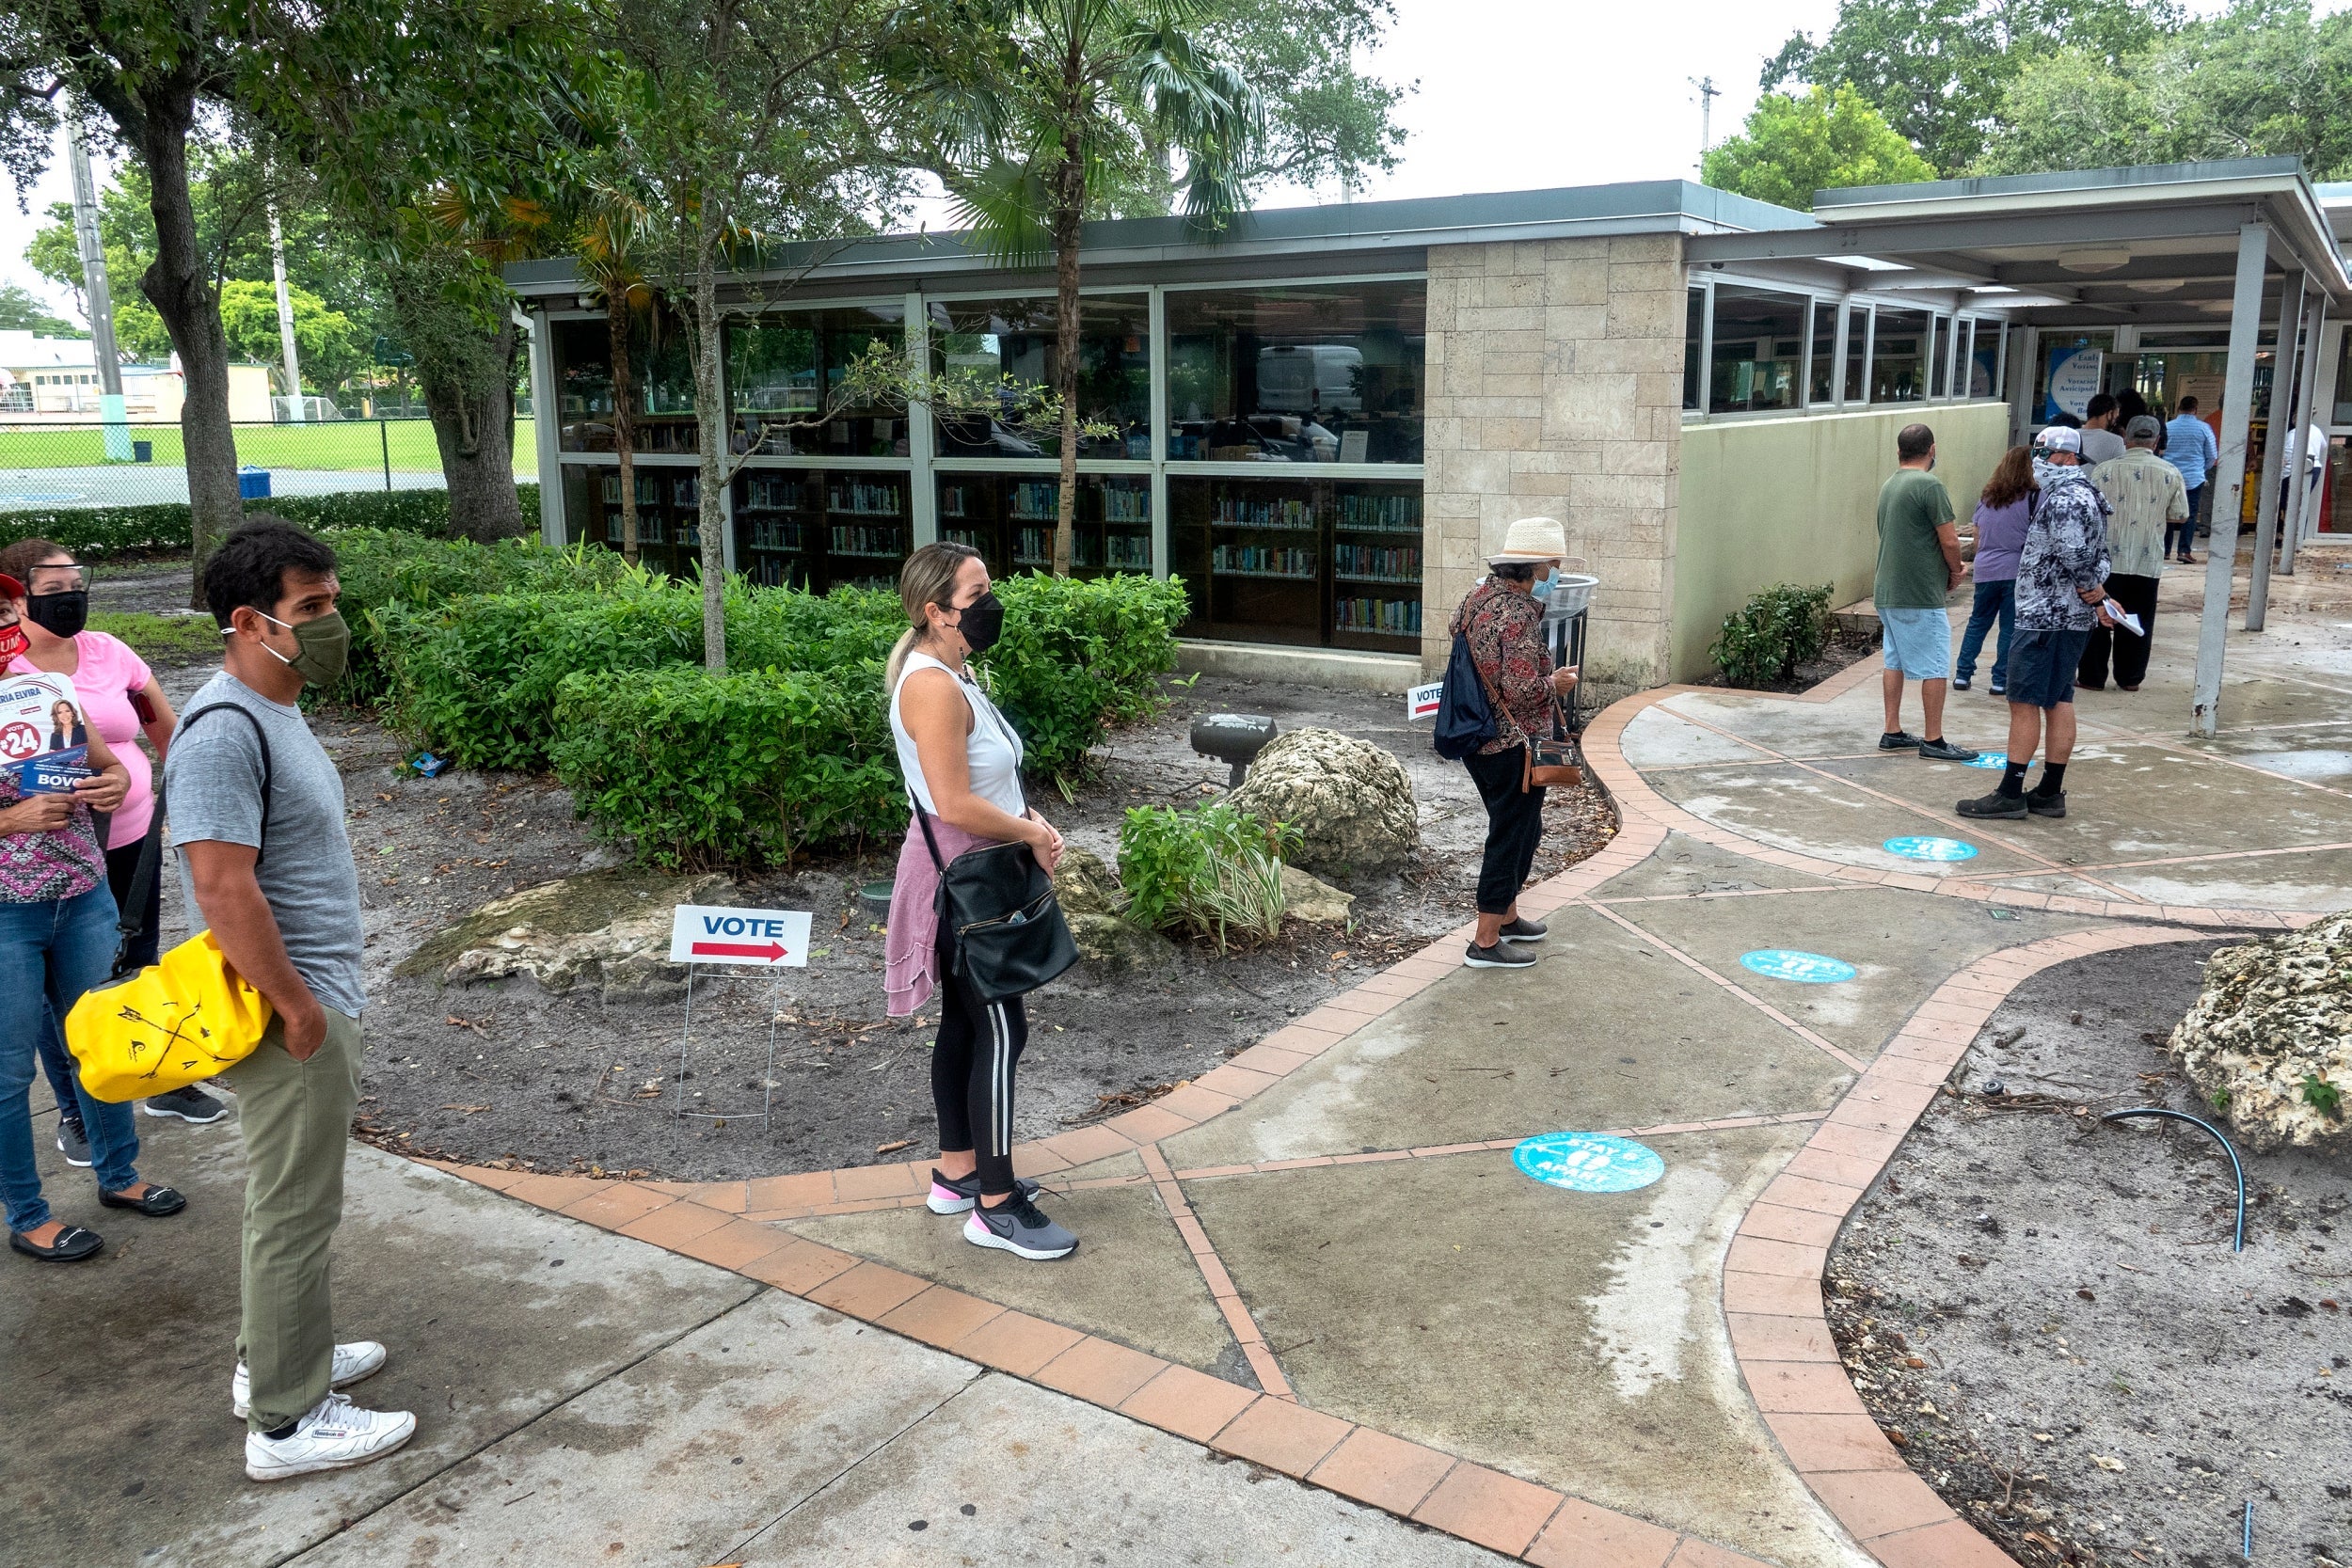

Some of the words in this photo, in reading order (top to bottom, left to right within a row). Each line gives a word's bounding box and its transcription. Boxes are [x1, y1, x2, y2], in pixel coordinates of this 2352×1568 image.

[14, 688, 41, 700] ELVIRA
[1417, 689, 1442, 702] VOTE
[704, 916, 785, 938] VOTE
